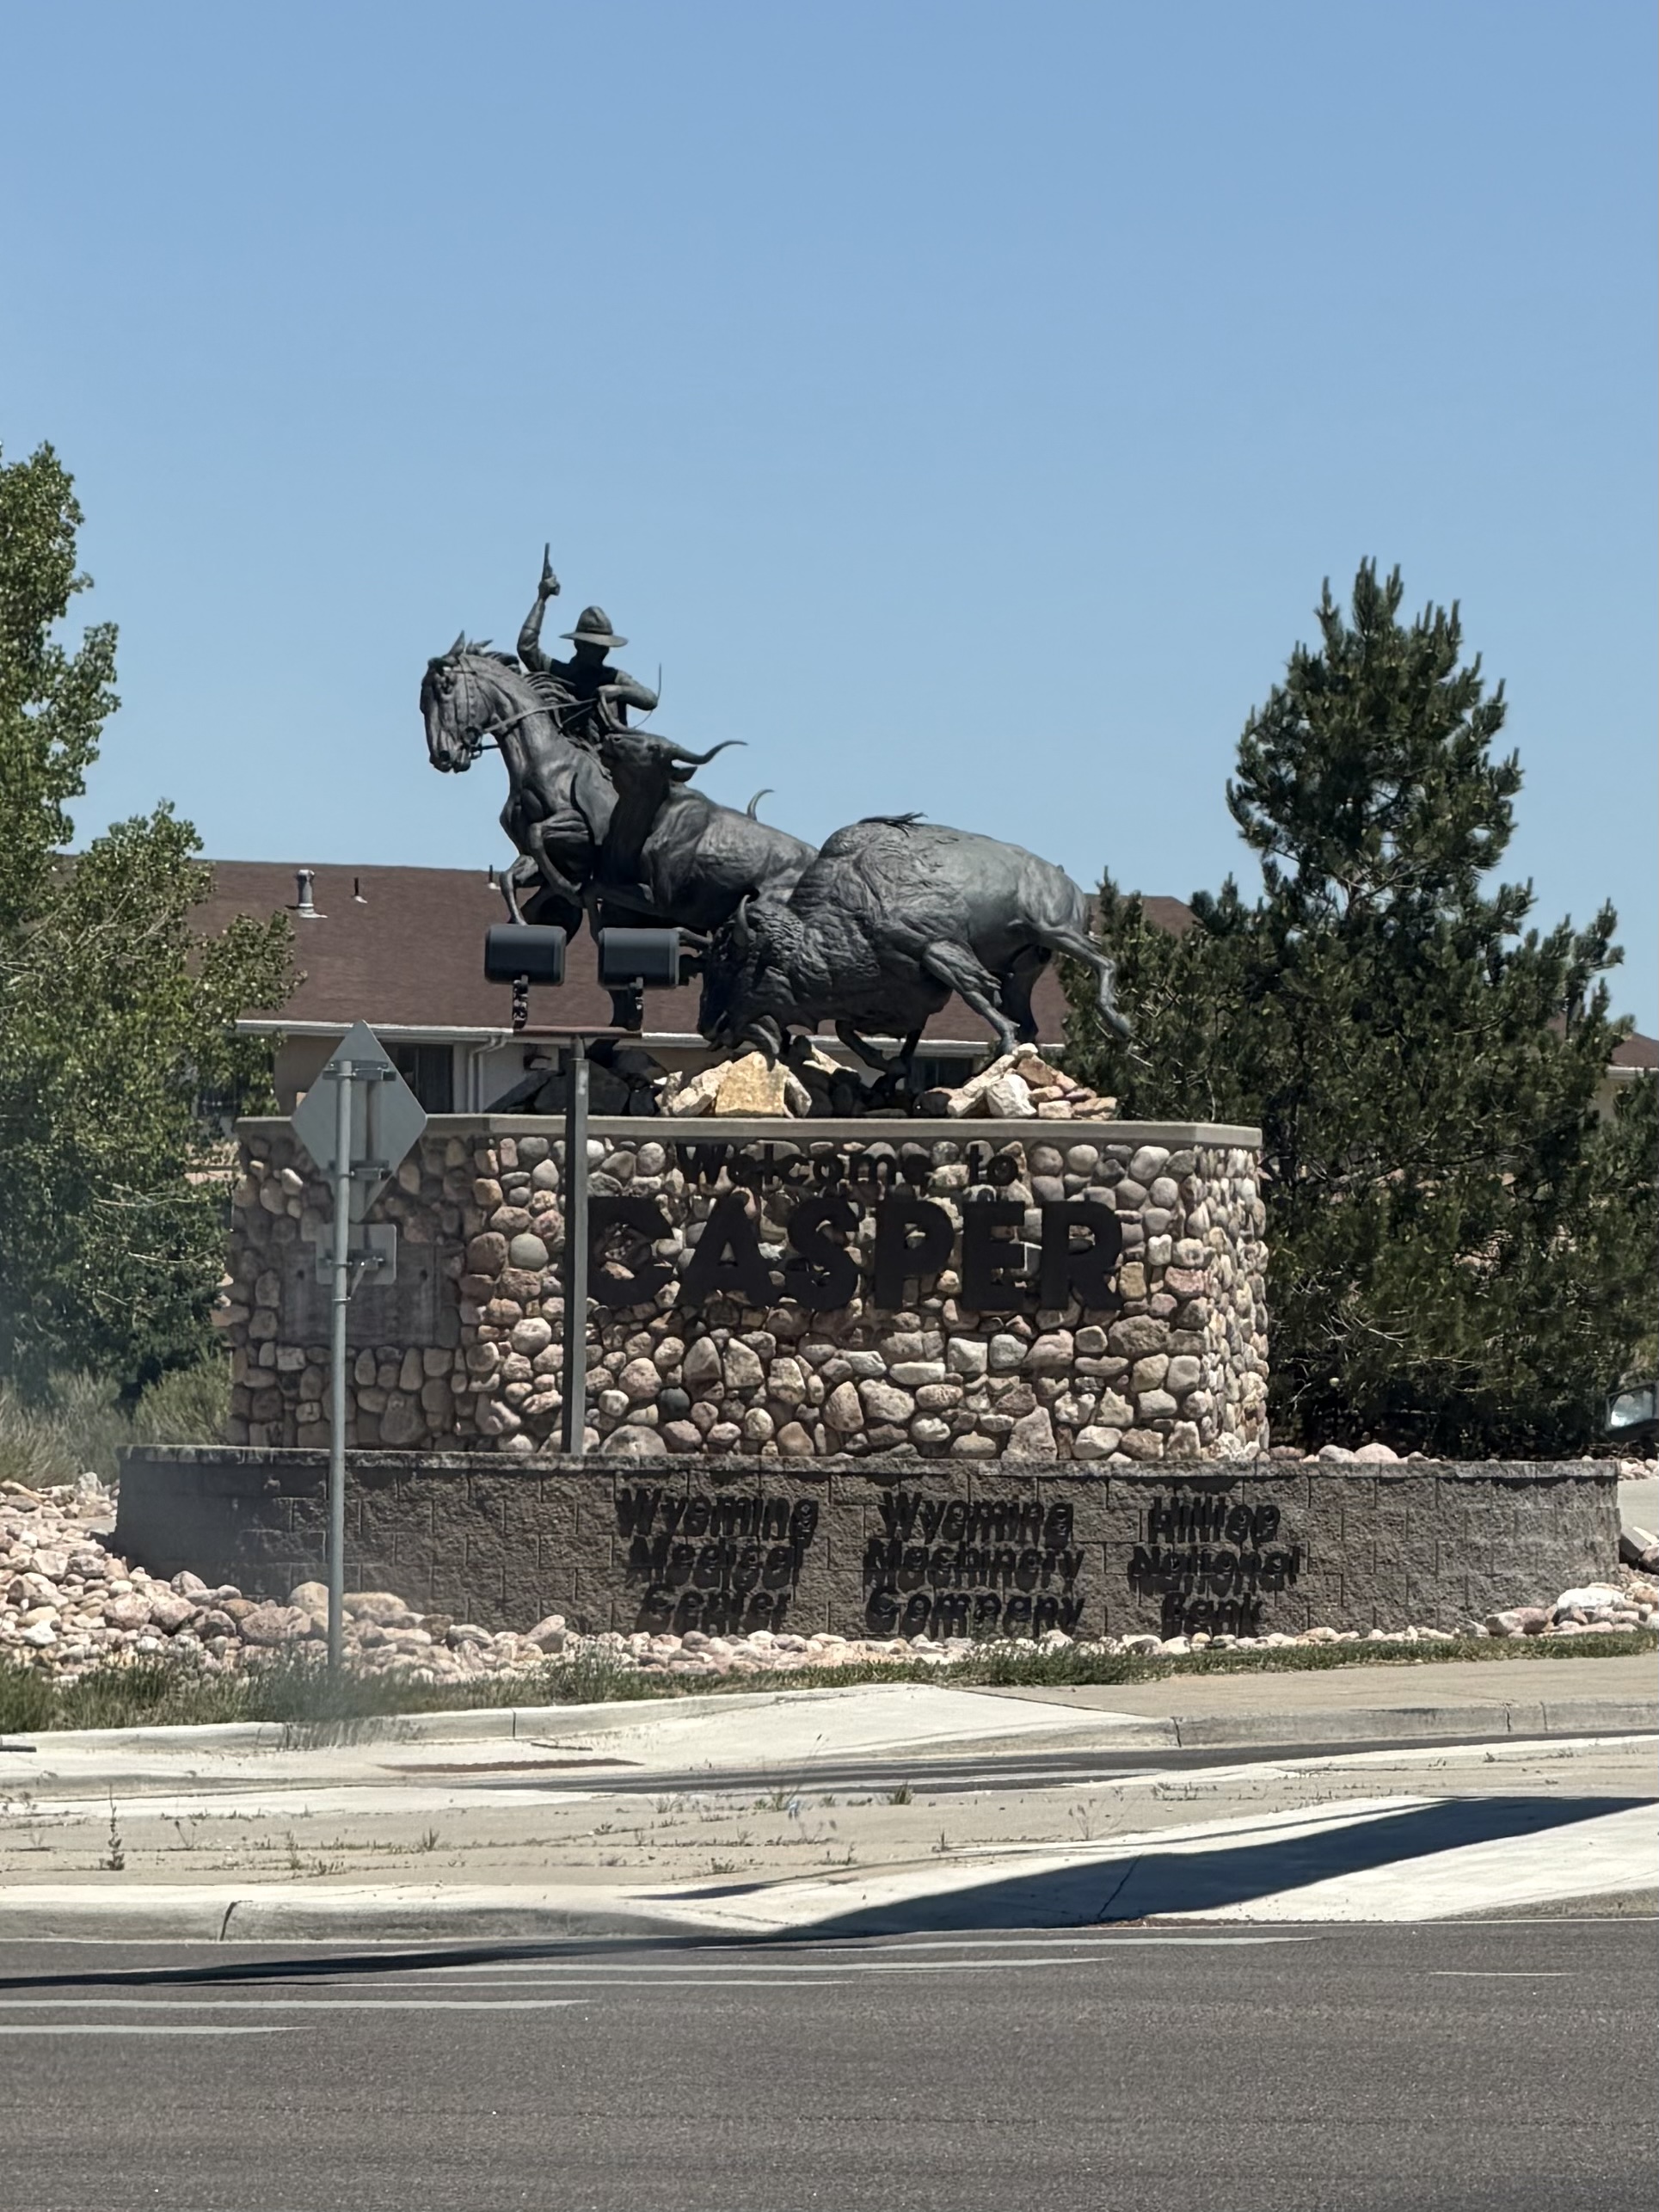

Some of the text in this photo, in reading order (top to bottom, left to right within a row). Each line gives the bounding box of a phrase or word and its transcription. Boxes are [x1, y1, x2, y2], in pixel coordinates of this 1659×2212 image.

[677, 1143, 1018, 1187] Welcome to
[587, 1195, 1122, 1311] CASPER
[618, 1488, 819, 1542] Wyoming
[878, 1492, 1073, 1544] Wyoming
[1151, 1496, 1280, 1544] Hilltop
[630, 1534, 805, 1583] Medical
[865, 1539, 1084, 1588] Machinery
[1129, 1545, 1300, 1586] National
[641, 1583, 790, 1628] Center
[866, 1587, 1084, 1632] Company
[1163, 1591, 1263, 1632] Bank
